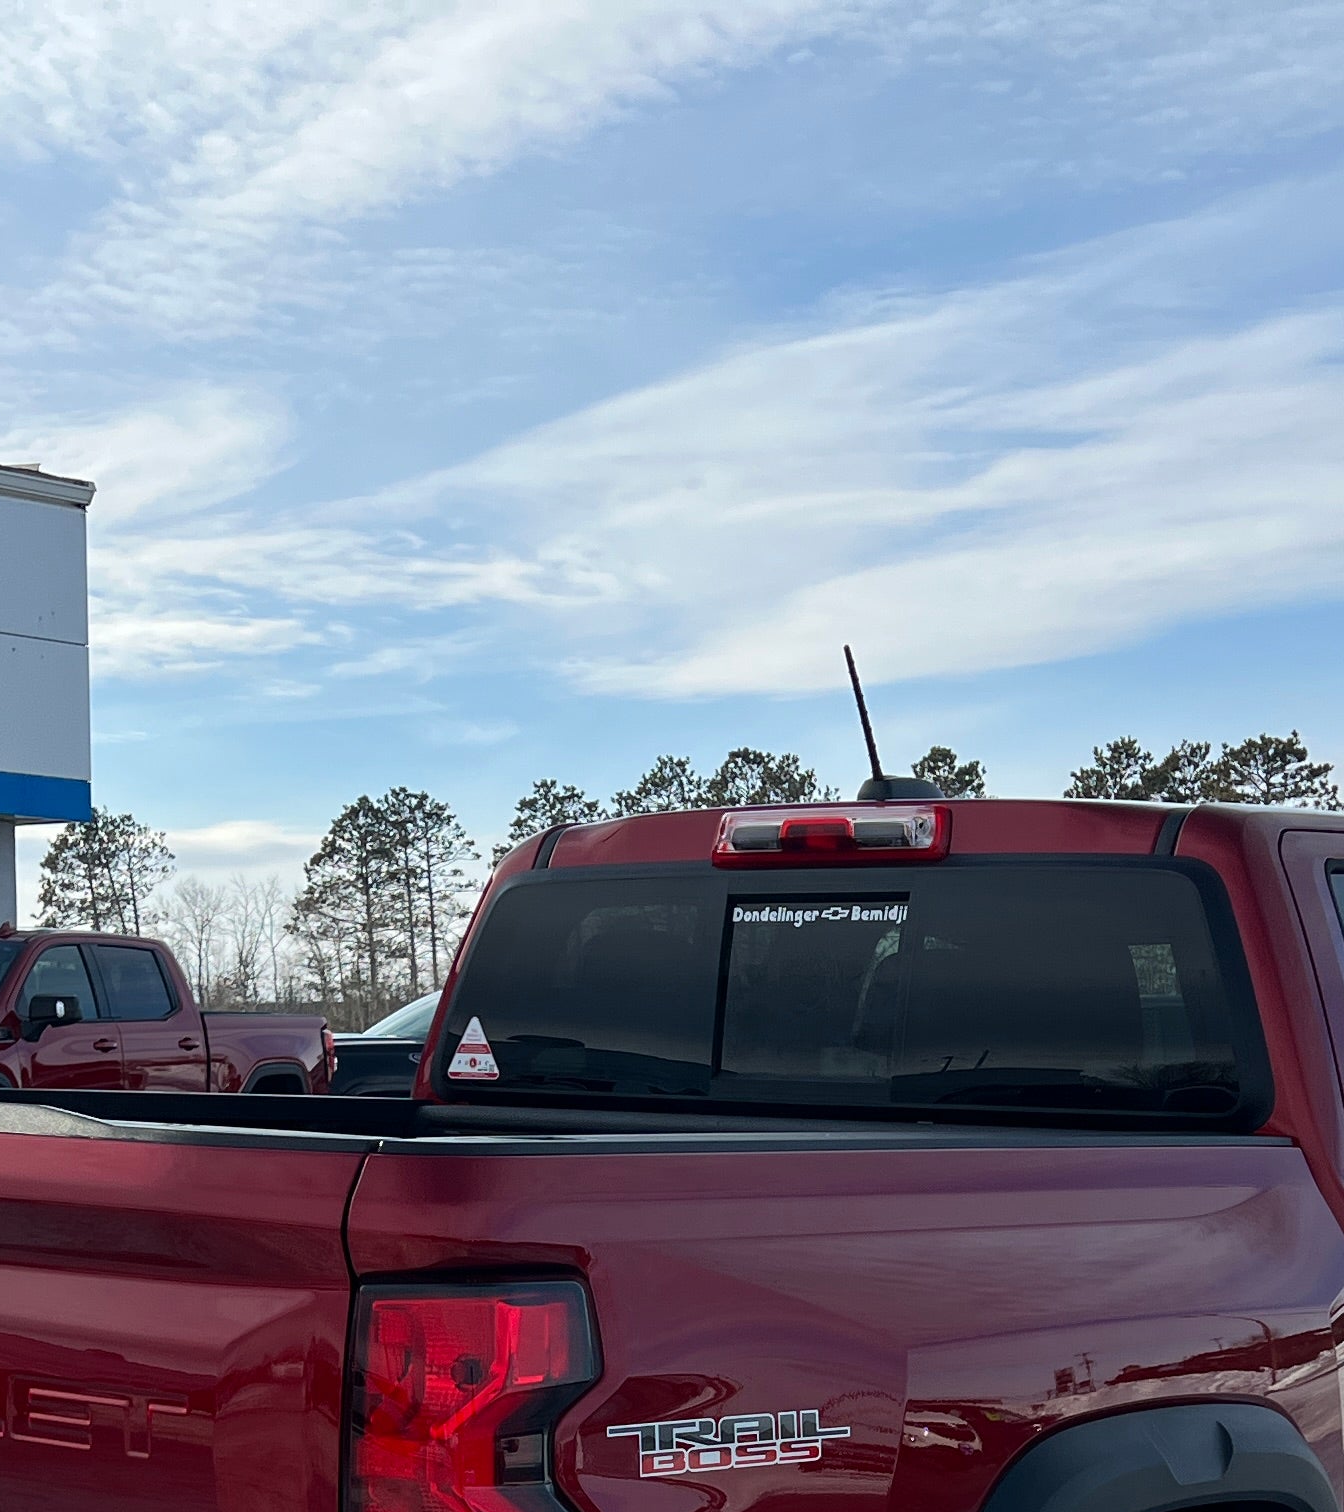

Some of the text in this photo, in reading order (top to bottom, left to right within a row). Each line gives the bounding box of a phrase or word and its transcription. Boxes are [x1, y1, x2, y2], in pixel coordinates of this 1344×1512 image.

[733, 905, 908, 928] Dondelinger Bemidji
[607, 1409, 851, 1453] TRAIL
[639, 1436, 823, 1477] BOSS
